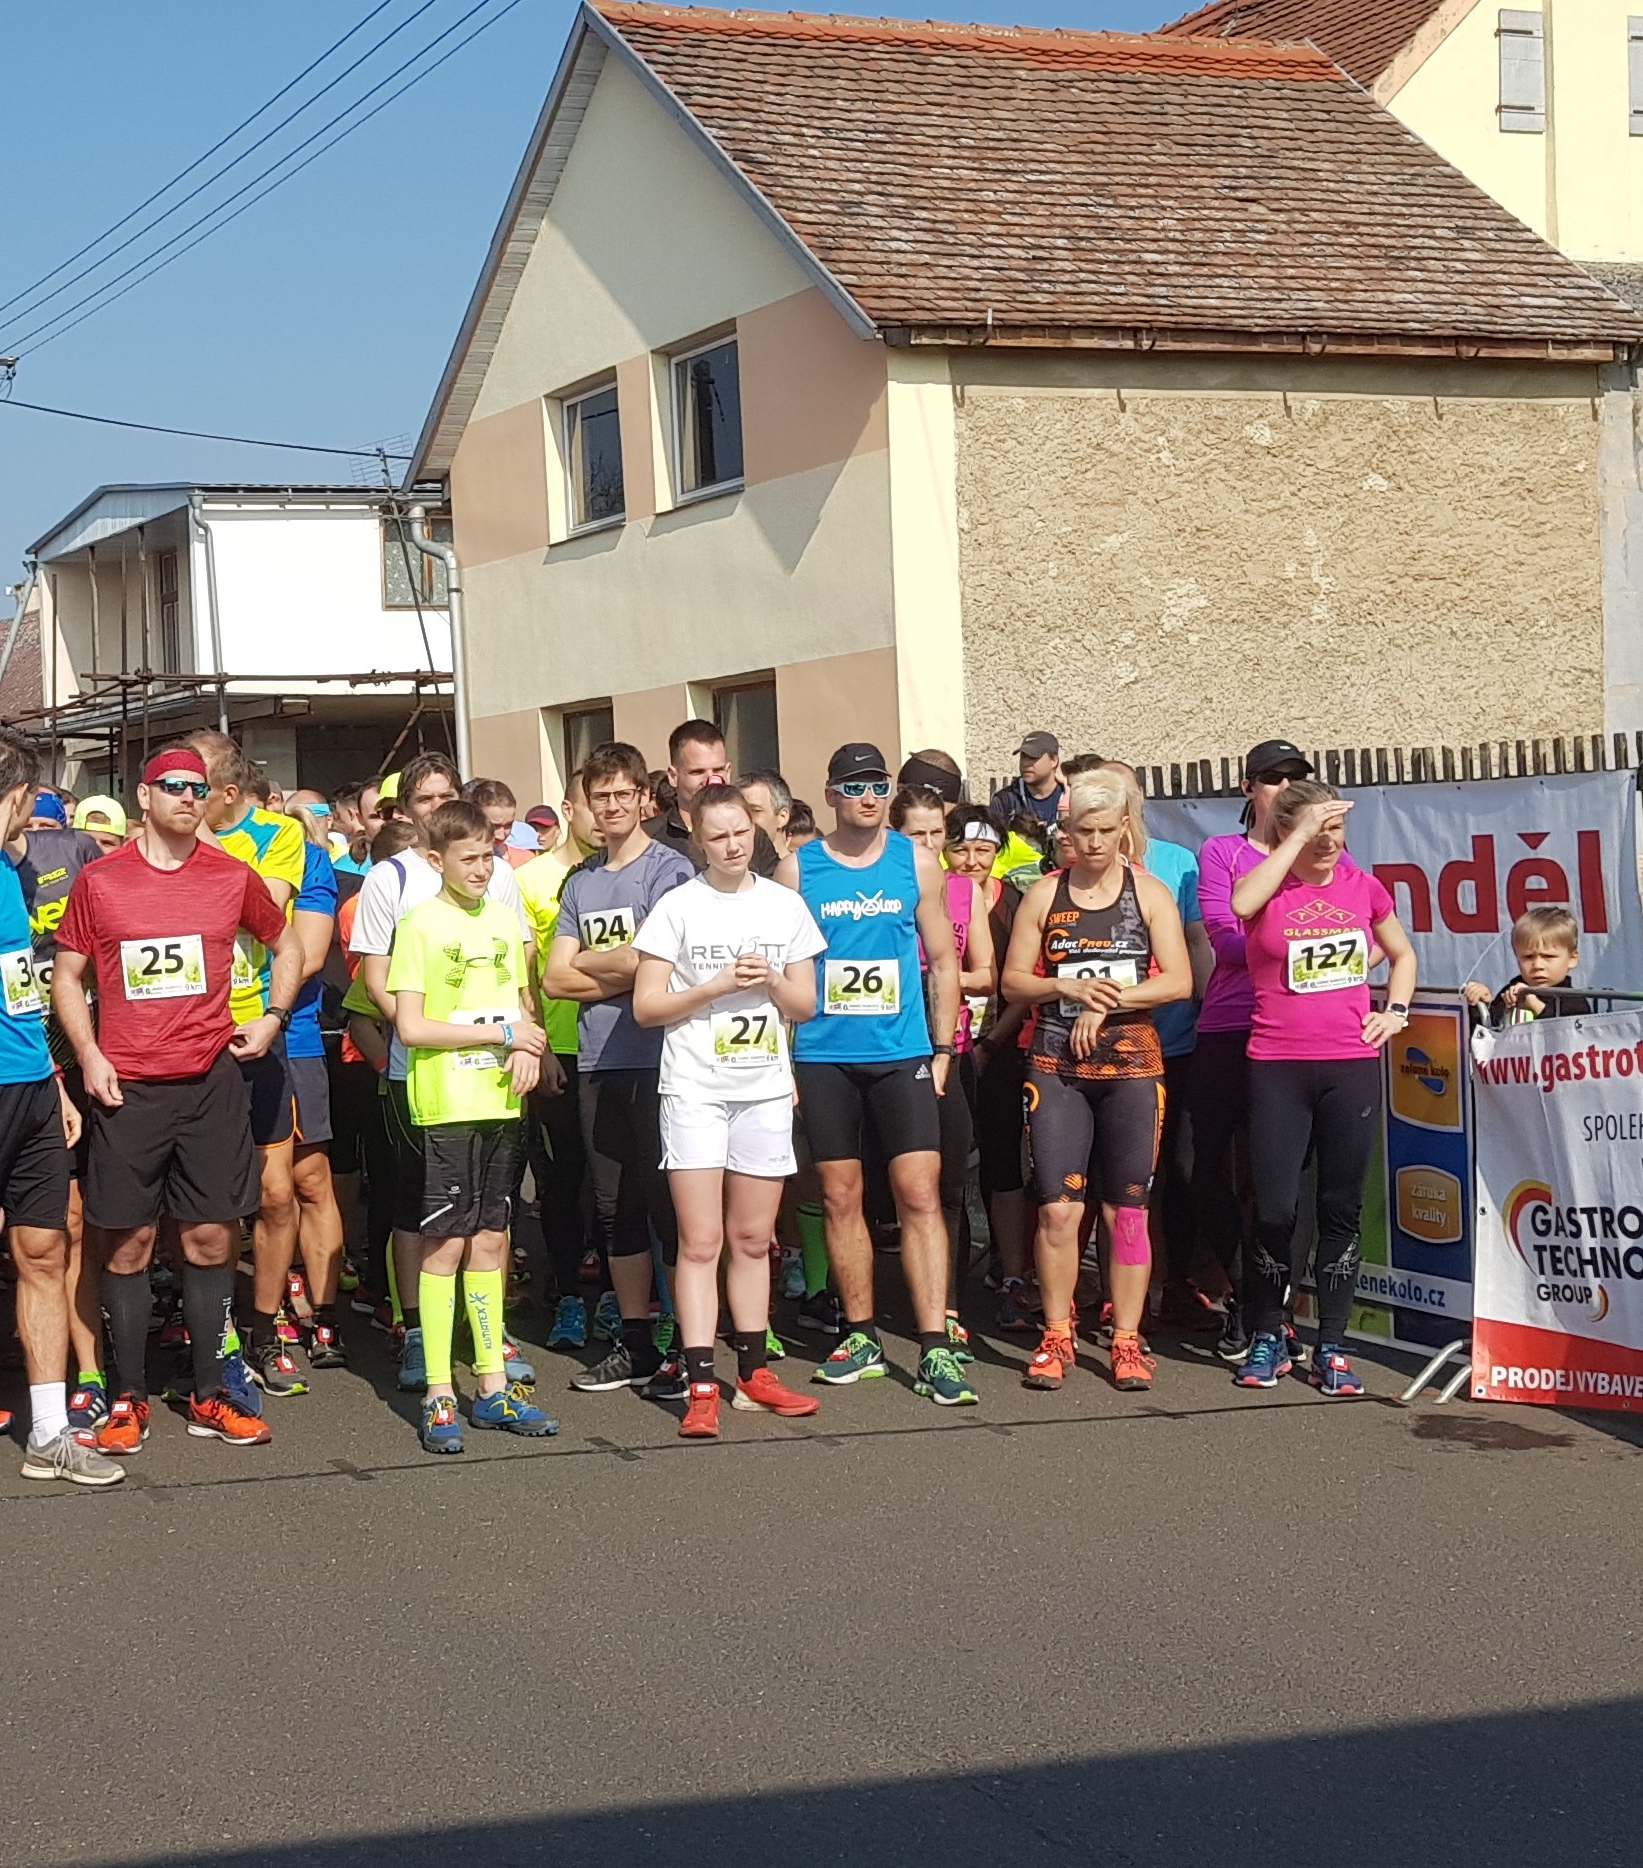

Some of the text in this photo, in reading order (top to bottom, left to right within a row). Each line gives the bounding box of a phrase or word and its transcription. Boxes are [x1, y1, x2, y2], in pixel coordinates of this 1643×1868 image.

[820, 899, 903, 921] HAPPY LOOP
[1048, 911, 1080, 925] SWEEP
[583, 914, 628, 946] 124
[140, 943, 184, 976] 25
[1300, 939, 1357, 972] 127
[17, 956, 36, 988] 3
[842, 966, 883, 994] 26
[730, 1015, 768, 1045] 27
[1410, 1183, 1447, 1201] záruka
[1412, 1203, 1447, 1228] kvality
[1531, 1204, 1643, 1240] GASTRO
[1533, 1244, 1643, 1281] TECHNO
[1356, 1272, 1446, 1308] enekolo.cz
[1536, 1283, 1593, 1305] GROUP
[1491, 1366, 1643, 1397] PRODEJ VYBAVE
